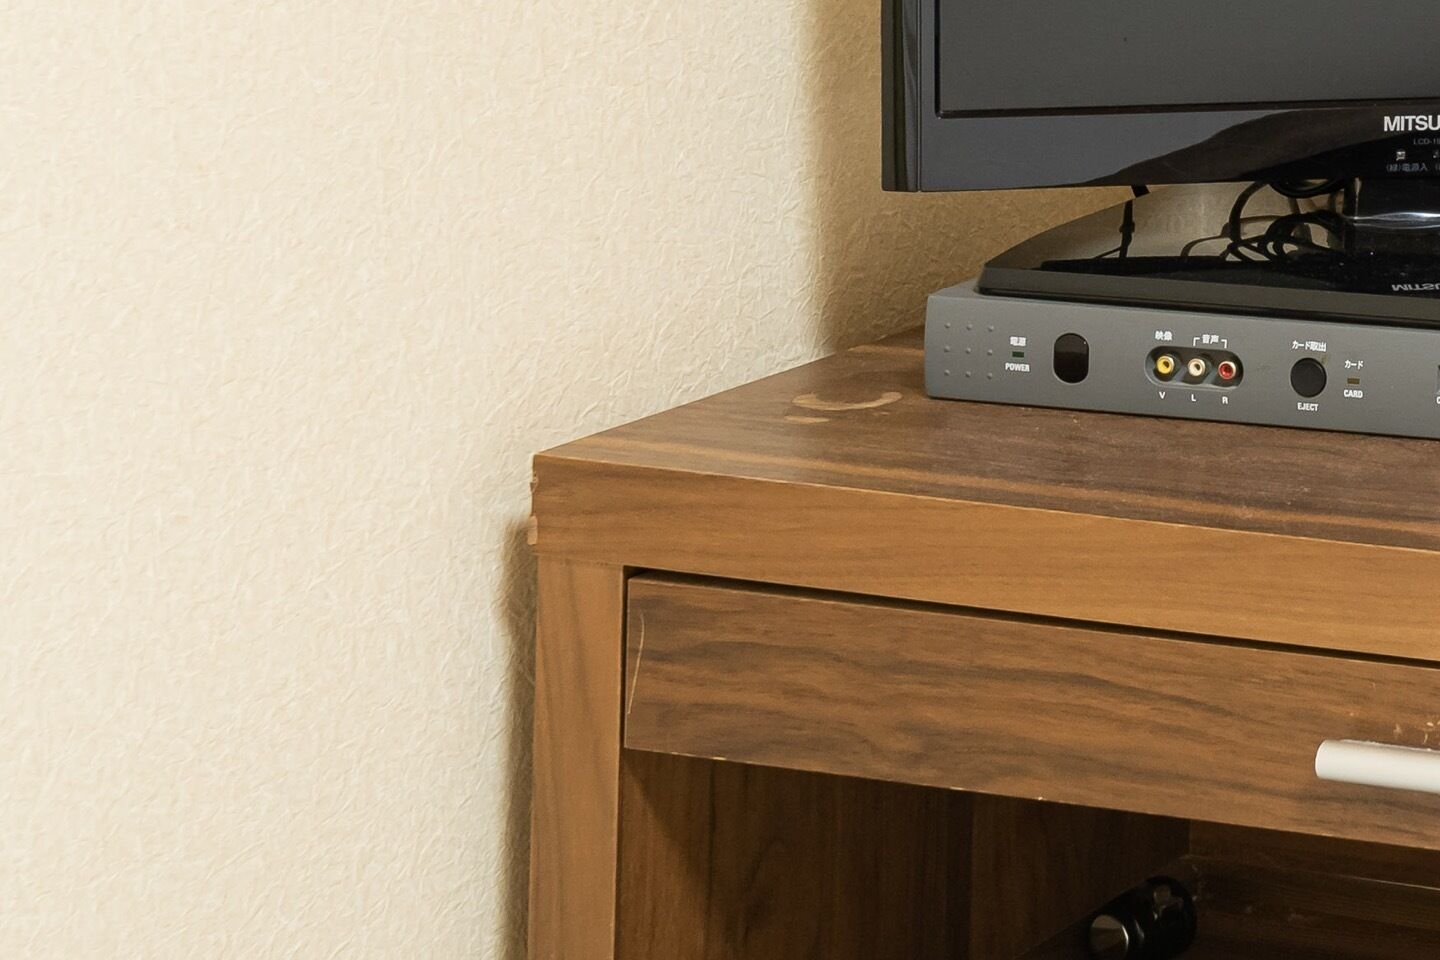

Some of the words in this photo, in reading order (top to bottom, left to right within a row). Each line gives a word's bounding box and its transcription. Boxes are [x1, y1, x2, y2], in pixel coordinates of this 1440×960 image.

[1155, 330, 1173, 341] 映像
[1202, 334, 1219, 344] 音声
[1009, 336, 1026, 347] 電源
[1292, 340, 1327, 352] カード取出
[1005, 362, 1030, 372] POWER
[1344, 360, 1363, 370] カード
[1159, 391, 1166, 399] V
[1191, 394, 1197, 402] L
[1343, 389, 1363, 399] CARD
[1222, 396, 1228, 404] R
[1297, 402, 1319, 411] EJECT
